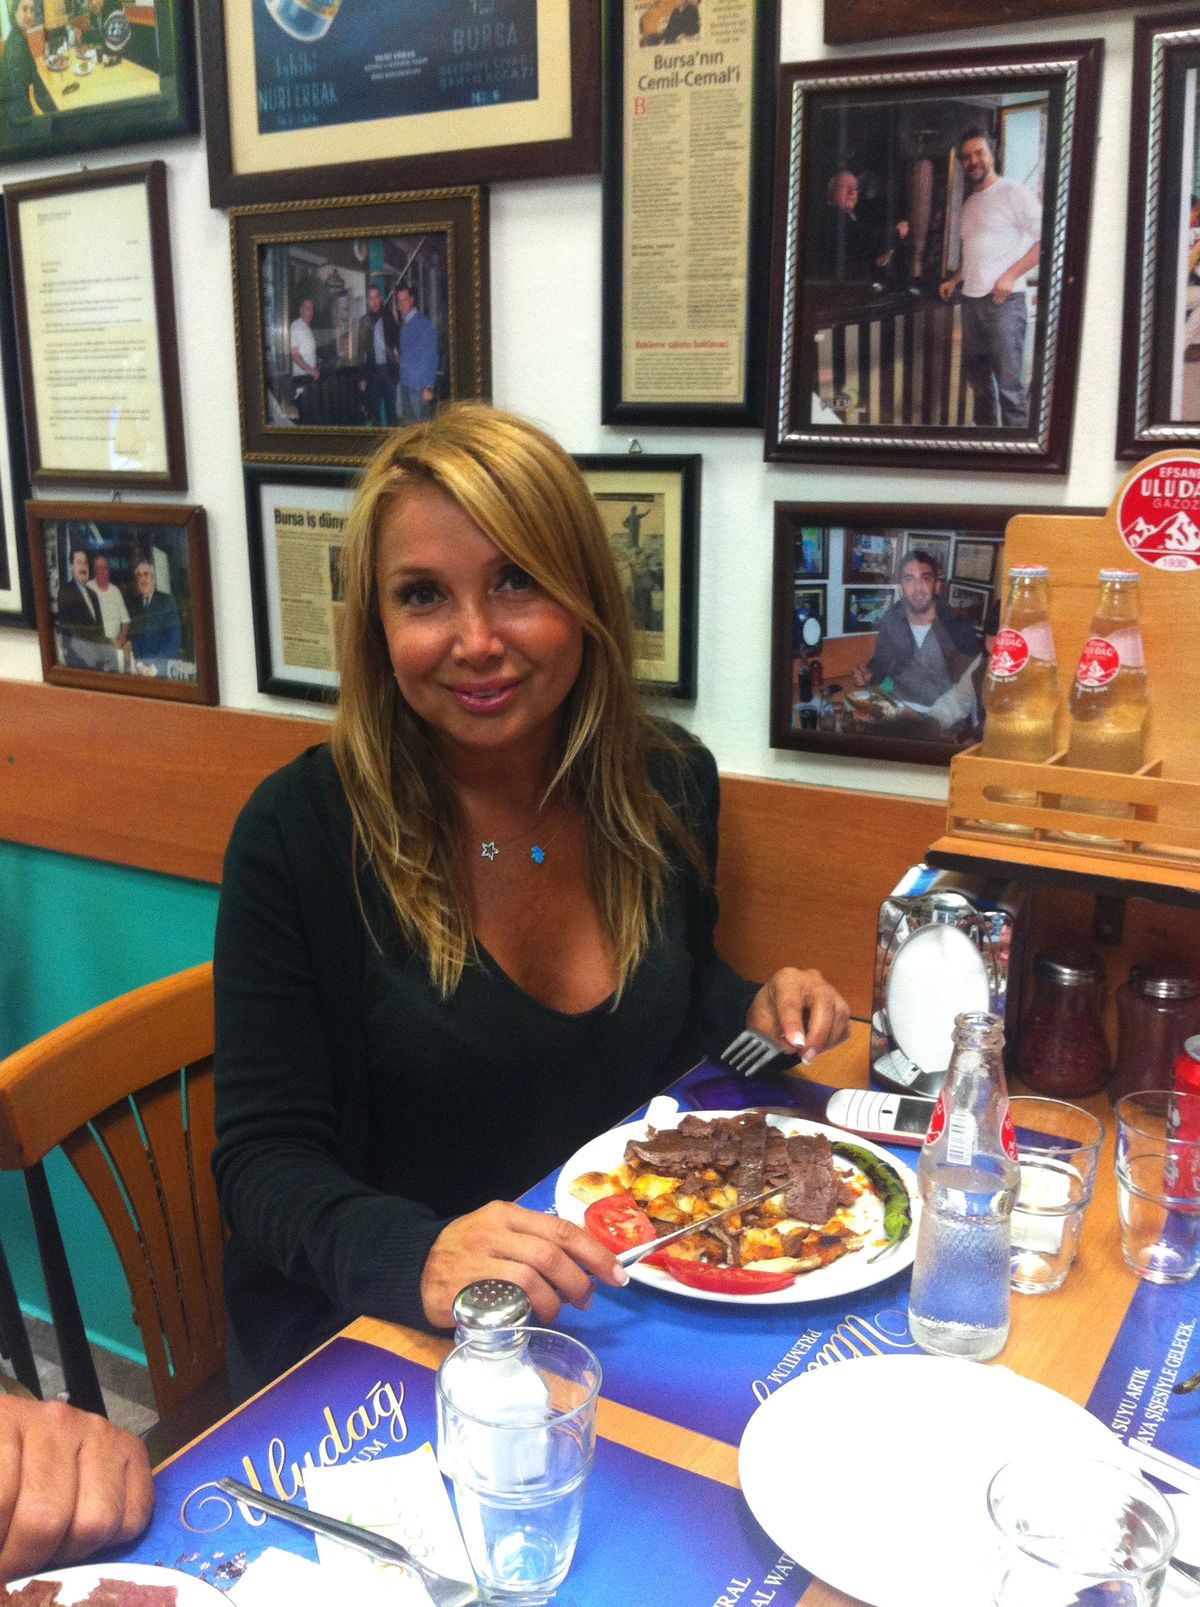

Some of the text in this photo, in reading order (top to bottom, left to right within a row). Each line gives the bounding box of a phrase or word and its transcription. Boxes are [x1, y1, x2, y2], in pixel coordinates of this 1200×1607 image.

[637, 65, 741, 91] Cemil-Cemal'i
[274, 509, 304, 526] Bursa
[307, 510, 317, 528] is
[767, 1328, 823, 1385] PREMIUM
[1112, 1367, 1151, 1432] SUYU ARTIK
